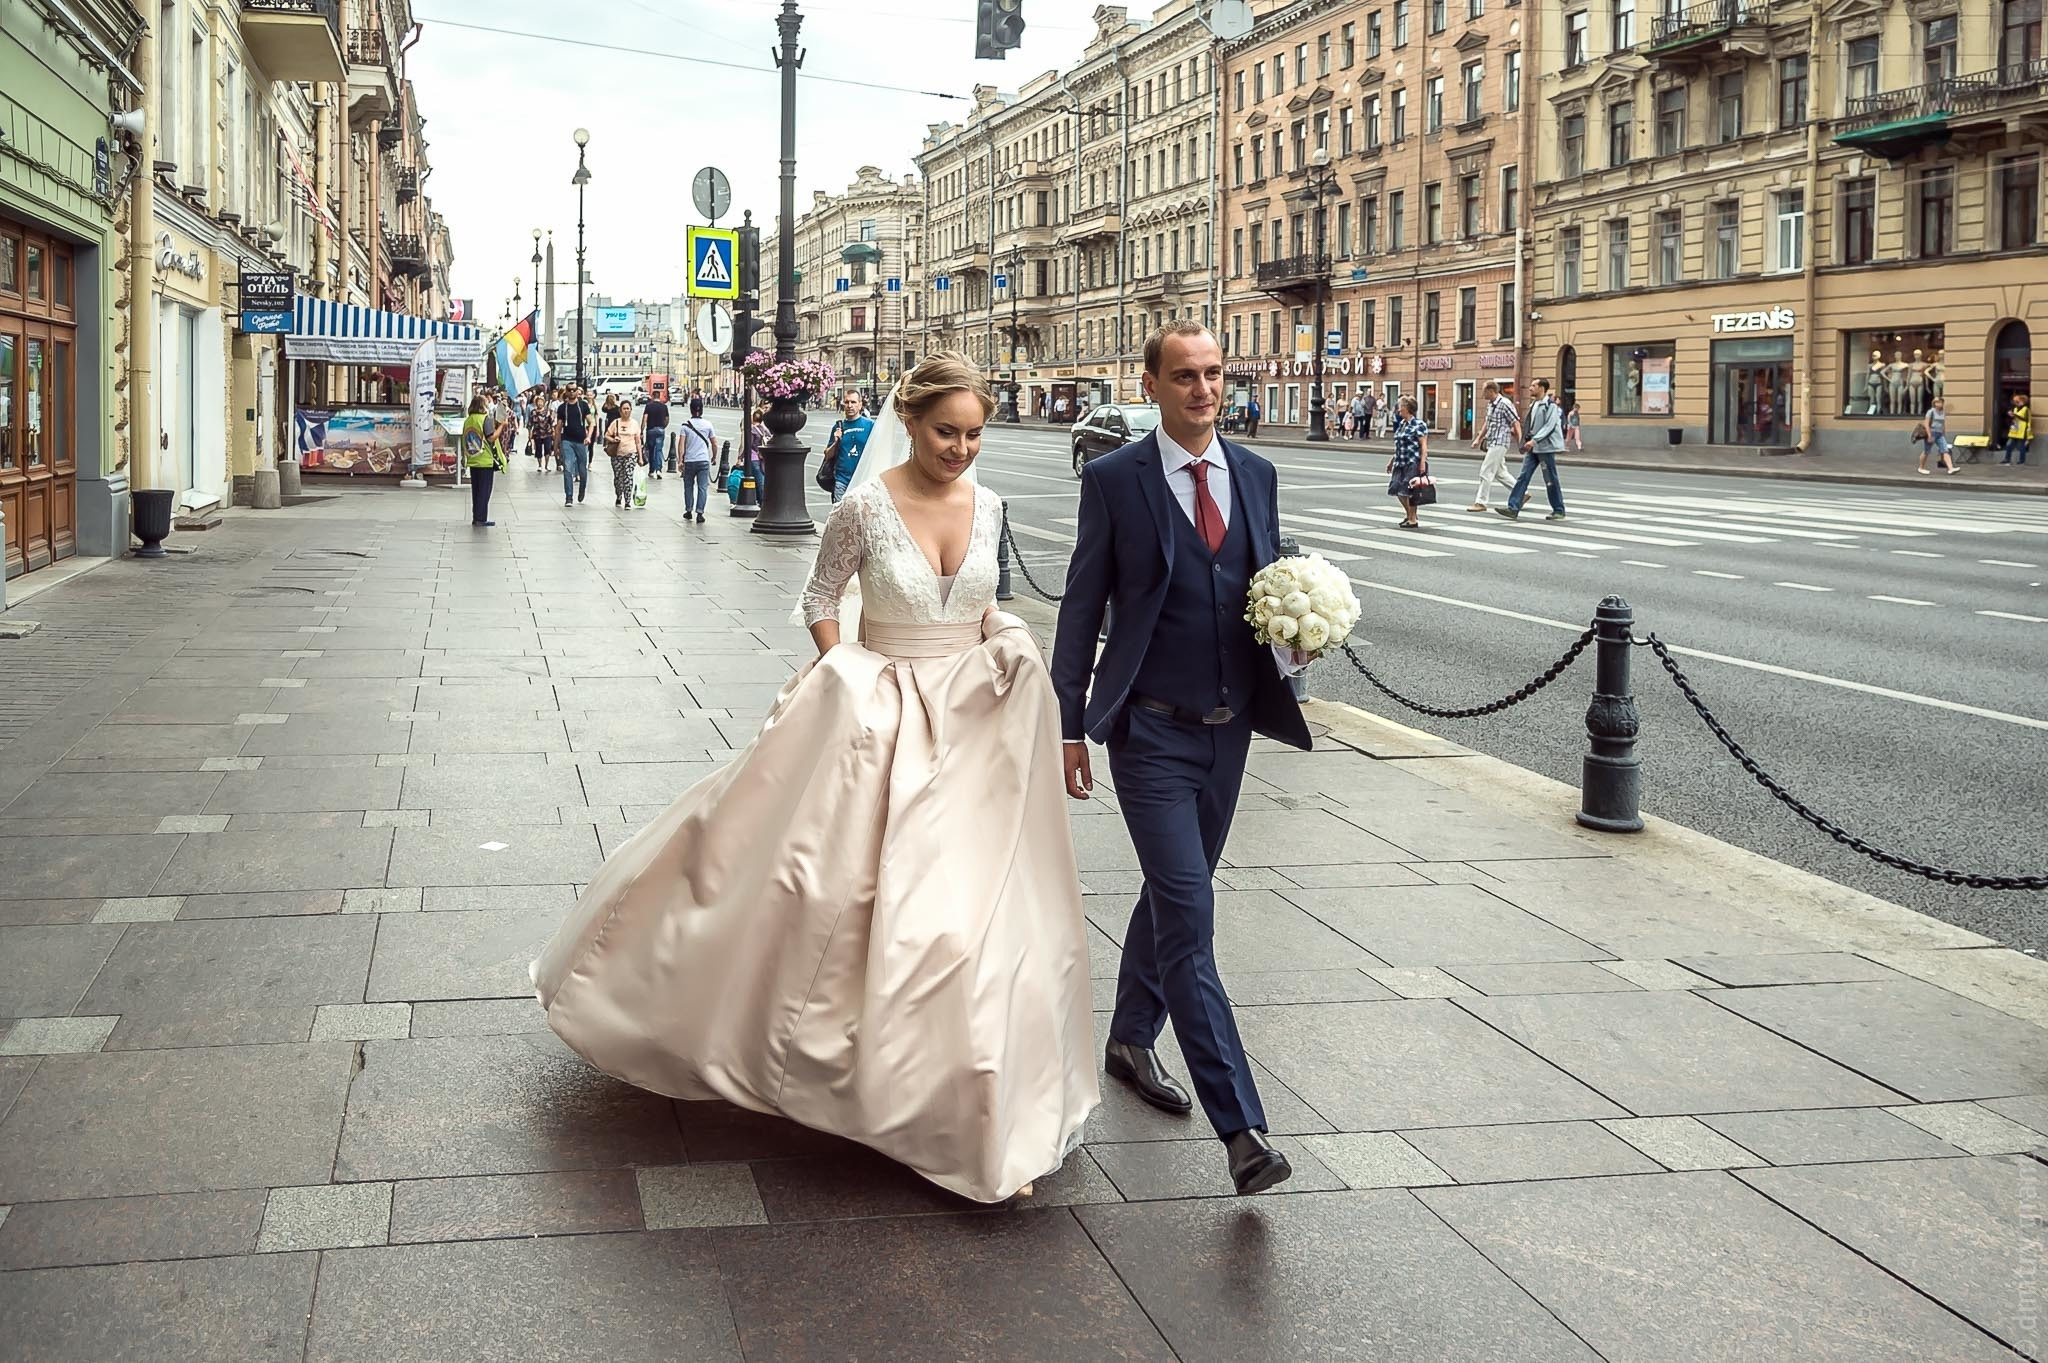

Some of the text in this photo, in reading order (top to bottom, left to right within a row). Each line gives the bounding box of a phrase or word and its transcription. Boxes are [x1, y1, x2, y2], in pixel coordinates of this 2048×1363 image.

[261, 275, 276, 285] РА
[247, 284, 289, 294] ОТЕЛЬ
[257, 320, 280, 331] Фото
[1282, 352, 1364, 377] ЗОЛОЙ
